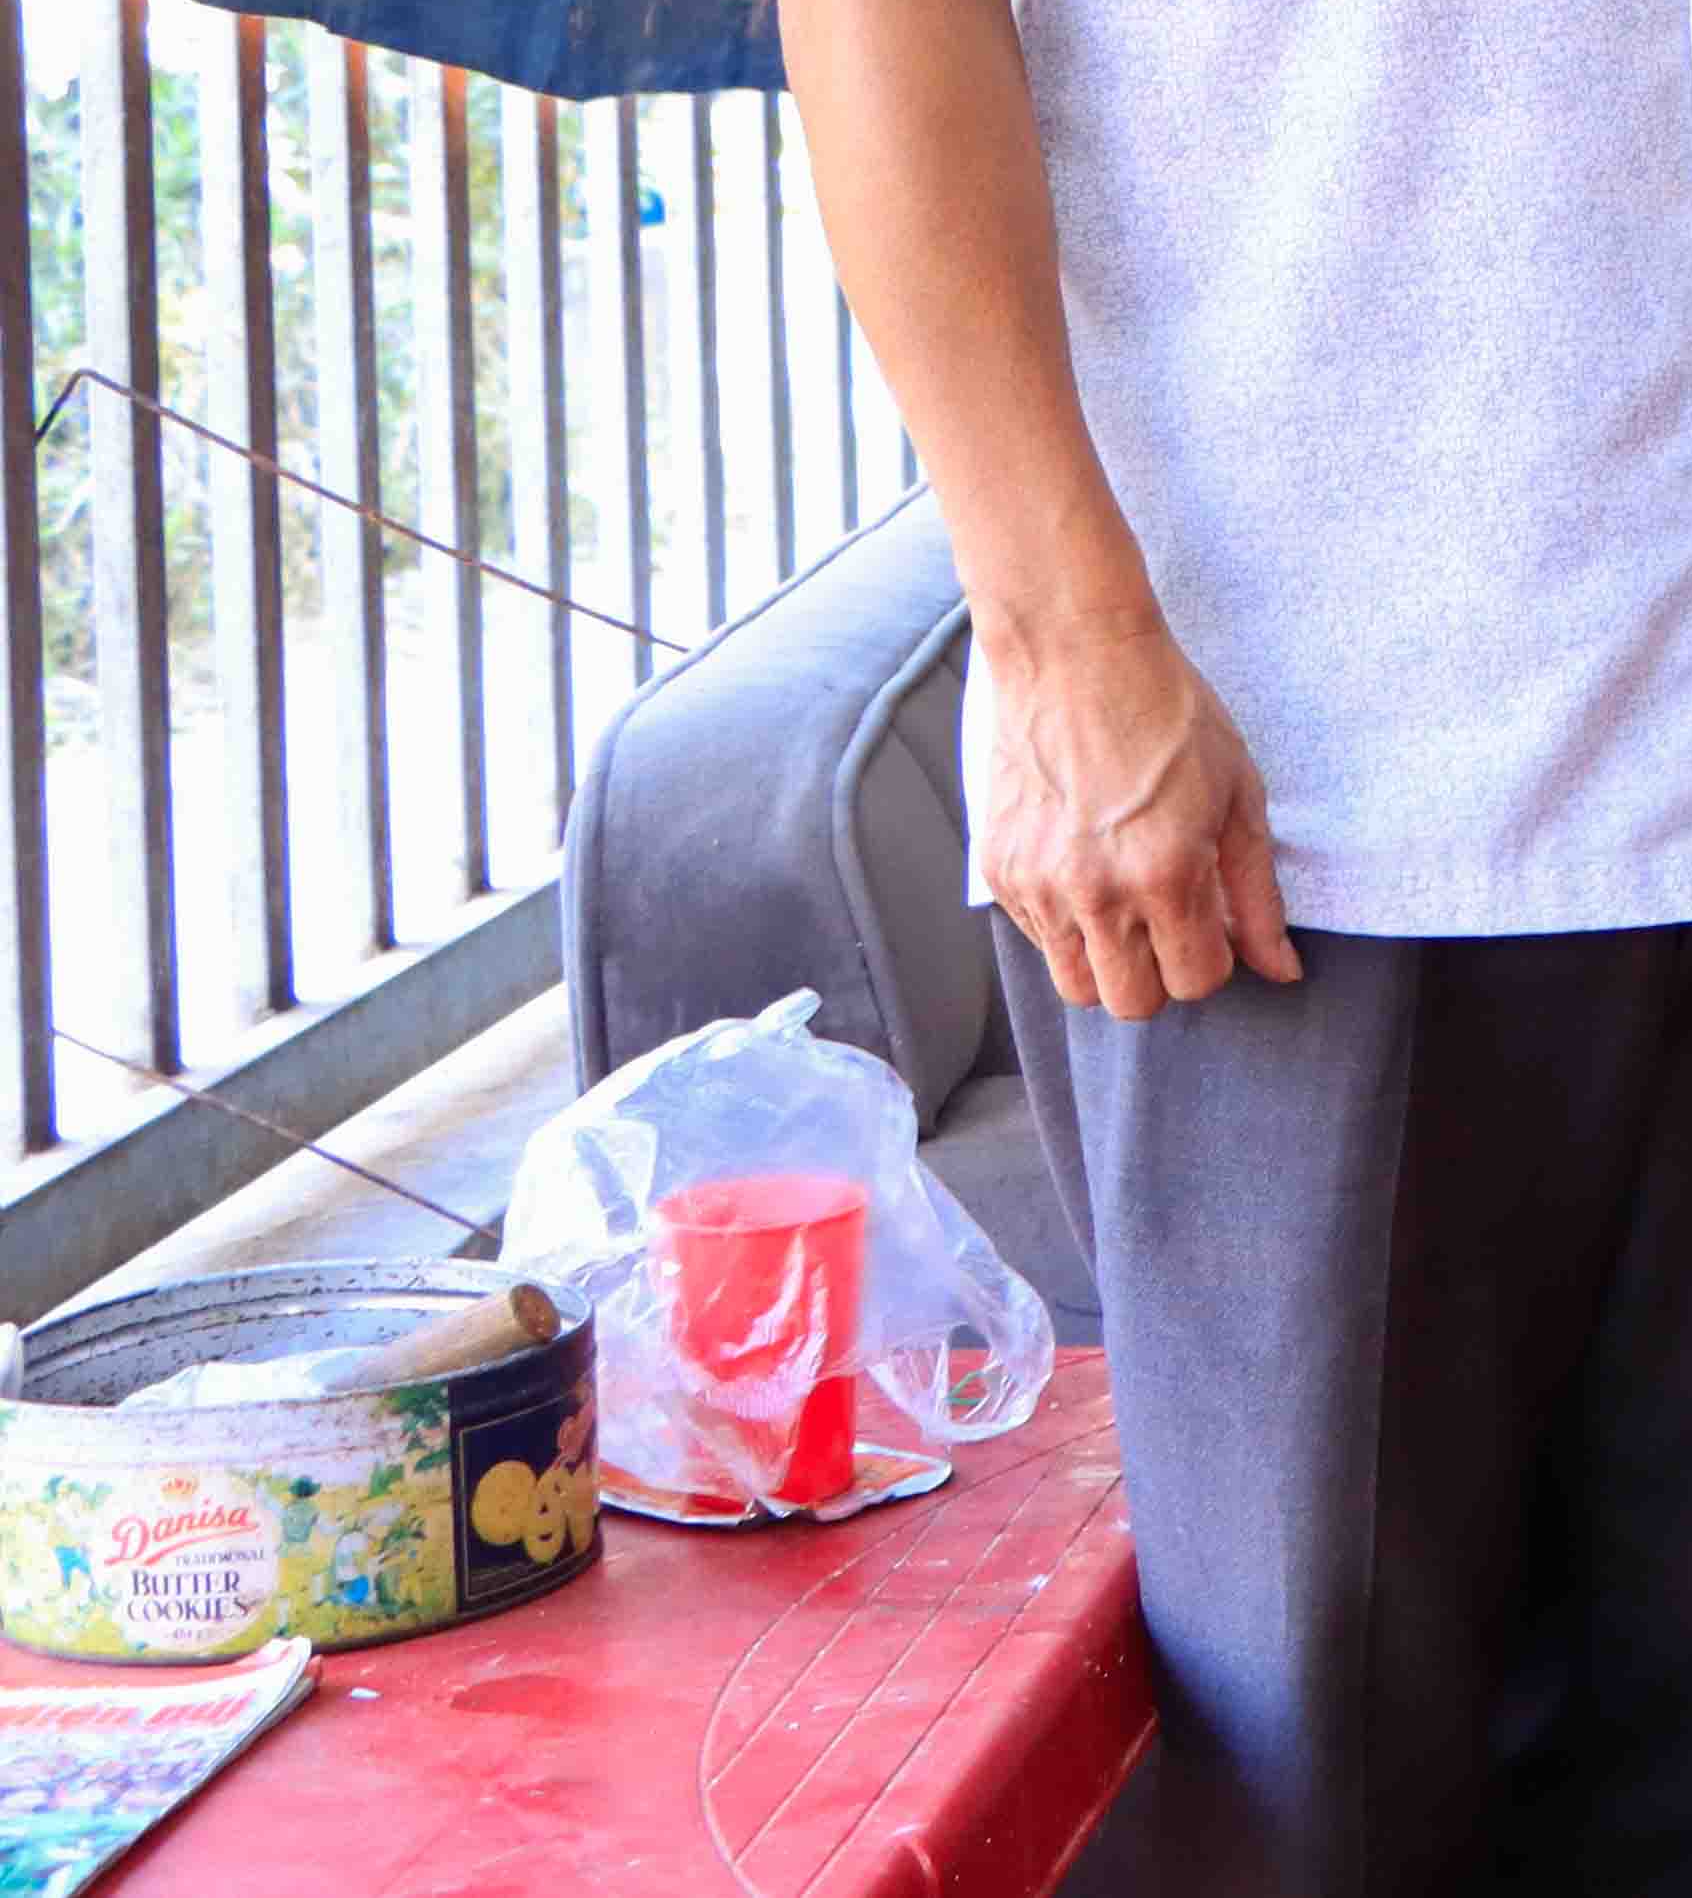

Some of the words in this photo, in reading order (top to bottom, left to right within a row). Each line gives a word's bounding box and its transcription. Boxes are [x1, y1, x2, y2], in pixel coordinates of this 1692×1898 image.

[104, 1498, 259, 1566] Danisa
[131, 1570, 241, 1597] BUTTER
[127, 1597, 251, 1622] COOKIES
